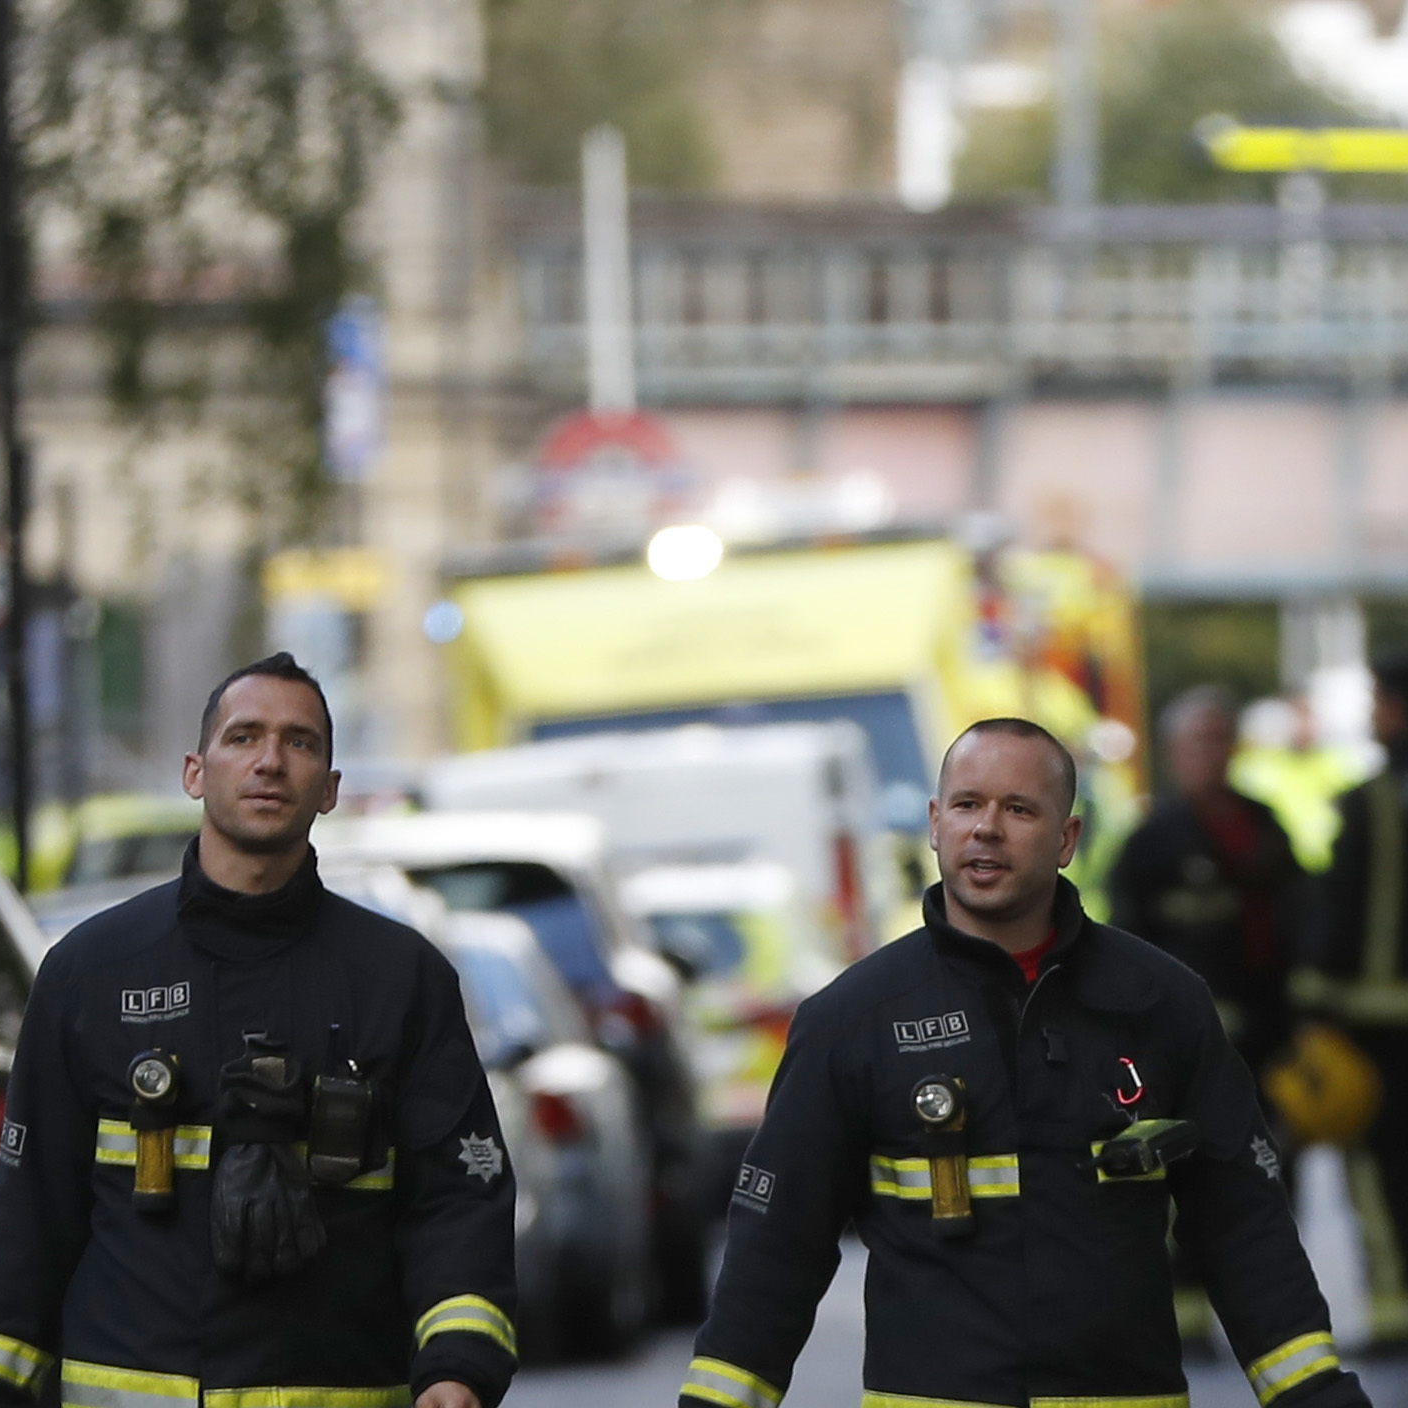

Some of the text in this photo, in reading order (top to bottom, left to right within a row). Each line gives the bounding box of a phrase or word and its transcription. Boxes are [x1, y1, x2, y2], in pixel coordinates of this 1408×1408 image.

[125, 985, 188, 1011] LFB
[898, 1014, 964, 1041] LFB
[737, 1168, 771, 1196] FB
